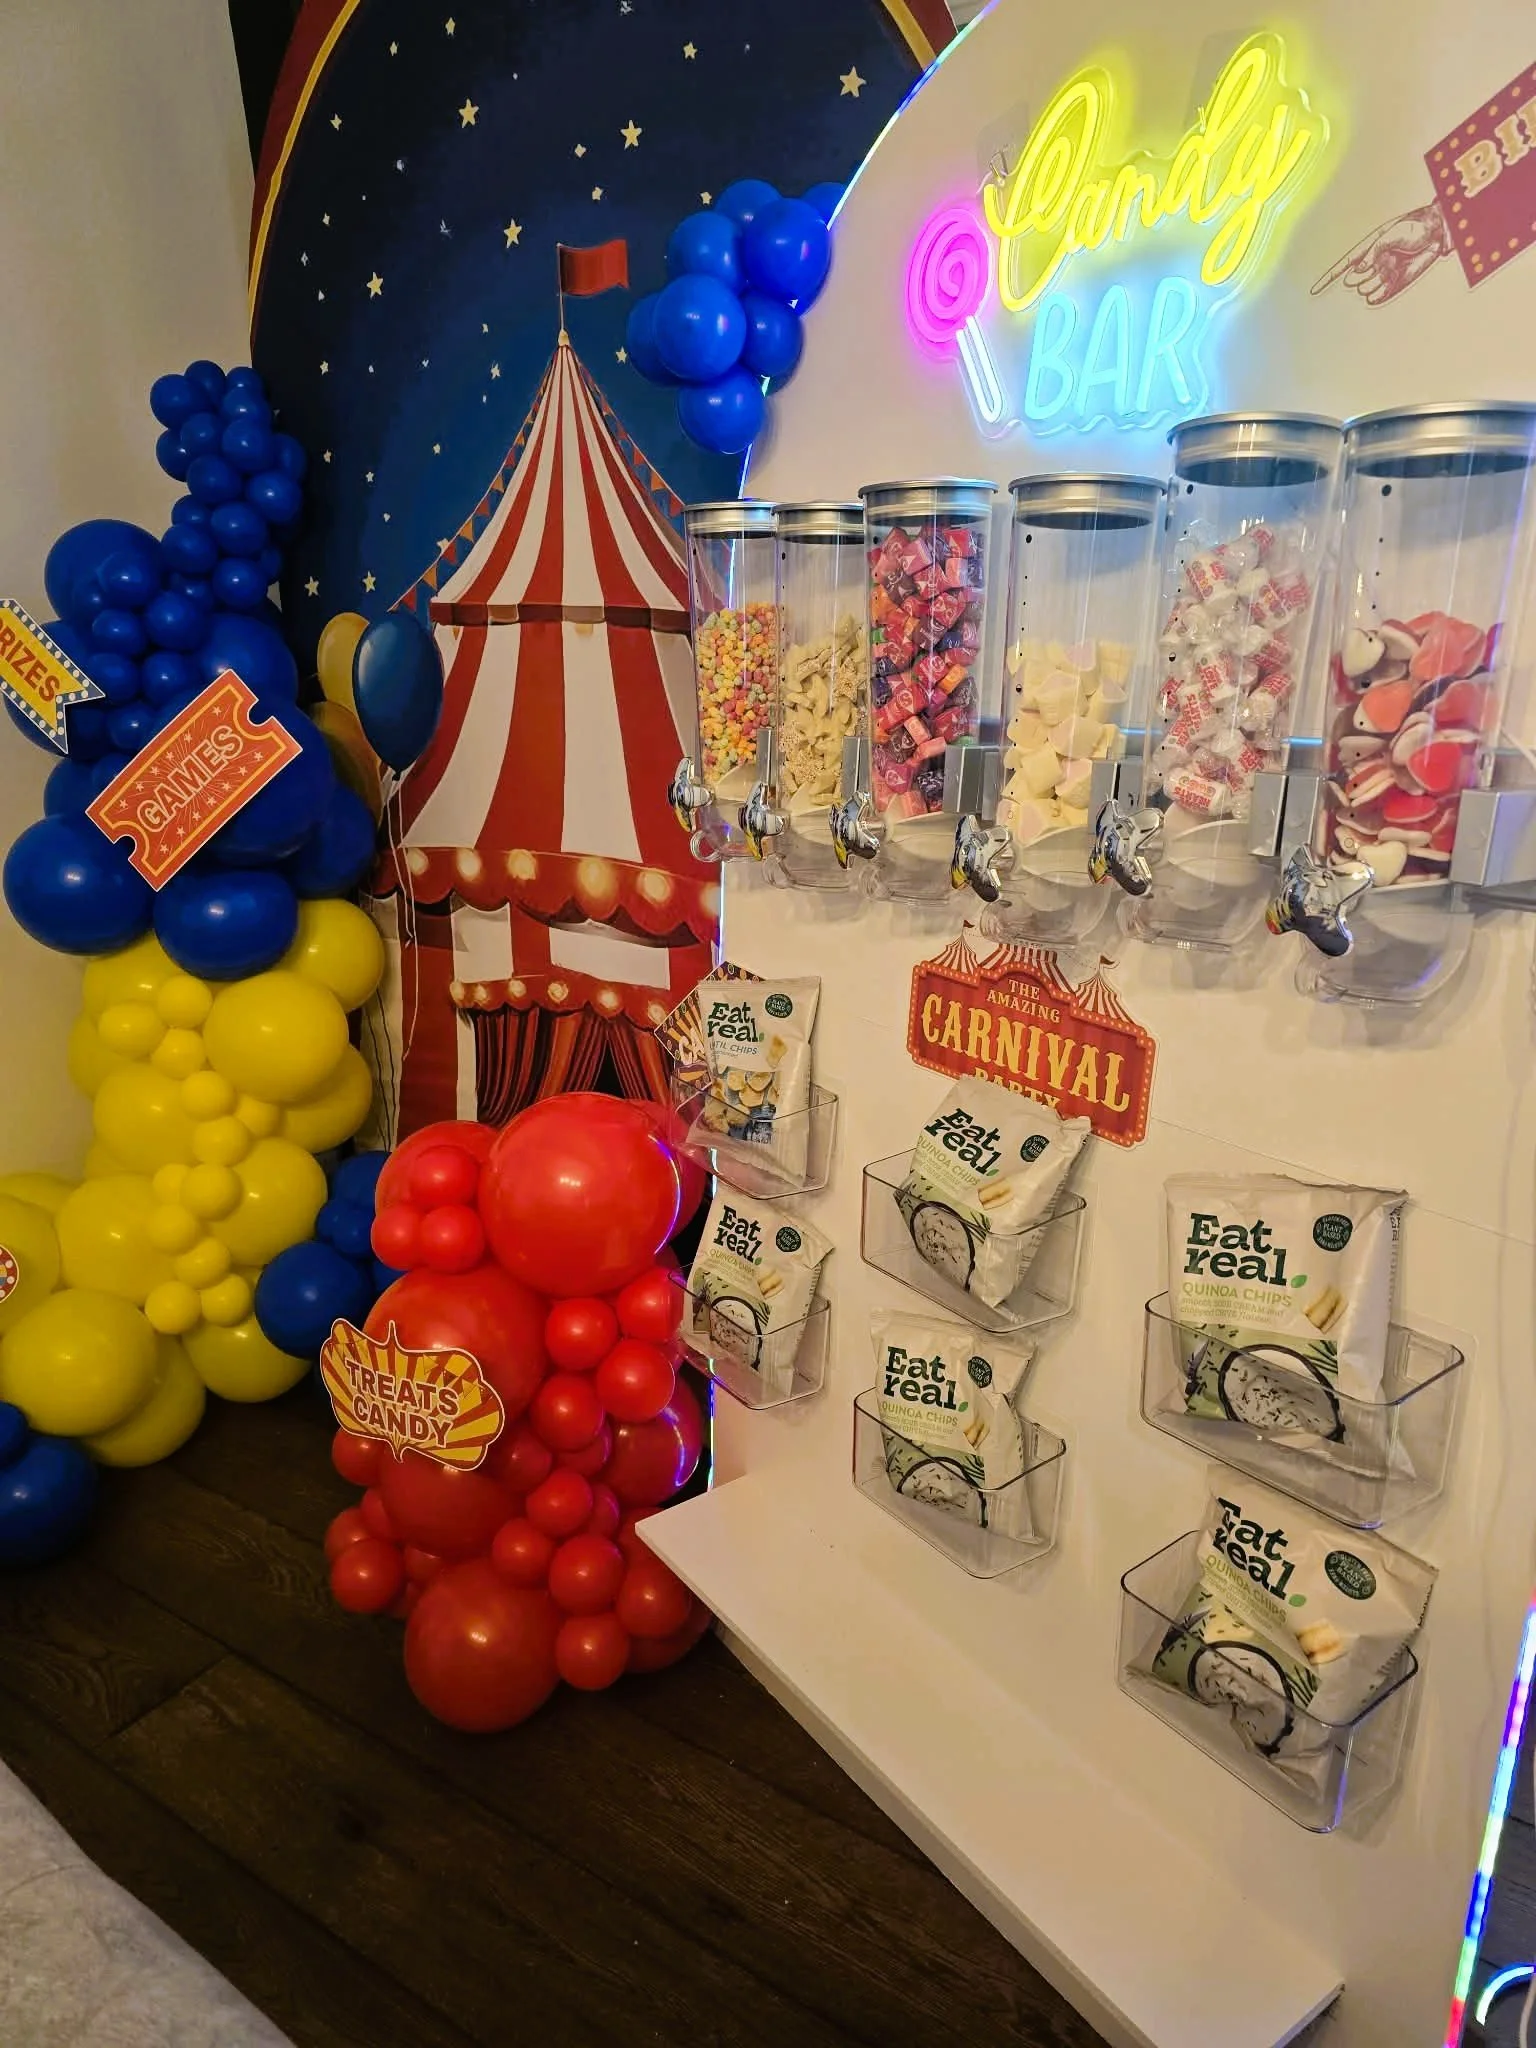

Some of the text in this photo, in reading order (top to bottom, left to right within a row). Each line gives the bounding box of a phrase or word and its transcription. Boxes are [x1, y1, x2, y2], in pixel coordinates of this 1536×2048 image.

[984, 48, 1311, 312] Candy
[1024, 276, 1198, 419] BAR
[0, 617, 60, 702] RIZES
[137, 725, 243, 833] GAMES
[986, 989, 1060, 1023] AMAZING
[1008, 979, 1040, 1000] THE
[706, 1017, 759, 1042] real
[708, 1001, 752, 1024] Eat
[730, 1044, 758, 1055] CHIPS
[921, 993, 1130, 1113] CARNIVAL
[923, 1118, 1002, 1177] real
[943, 1107, 1001, 1151] Eat
[718, 1204, 762, 1242] Eat
[1186, 1212, 1272, 1254] Eat
[713, 1226, 763, 1263] real
[1183, 1247, 1287, 1287] real
[1182, 1281, 1292, 1307] QUINOA CHIPS
[886, 1345, 946, 1384] Eat
[345, 1357, 460, 1416] TREATS
[883, 1373, 957, 1411] real
[352, 1393, 454, 1448] CANDY
[882, 1401, 923, 1419] QUINOA
[926, 1411, 958, 1426] CHIPS
[1217, 1496, 1288, 1561] Eat
[1212, 1527, 1296, 1601] real
[1336, 1566, 1360, 1588] BASED
[1340, 1560, 1364, 1583] PLANT
[1206, 1554, 1250, 1595] QUINOA
[1253, 1589, 1286, 1623] CHIPS
